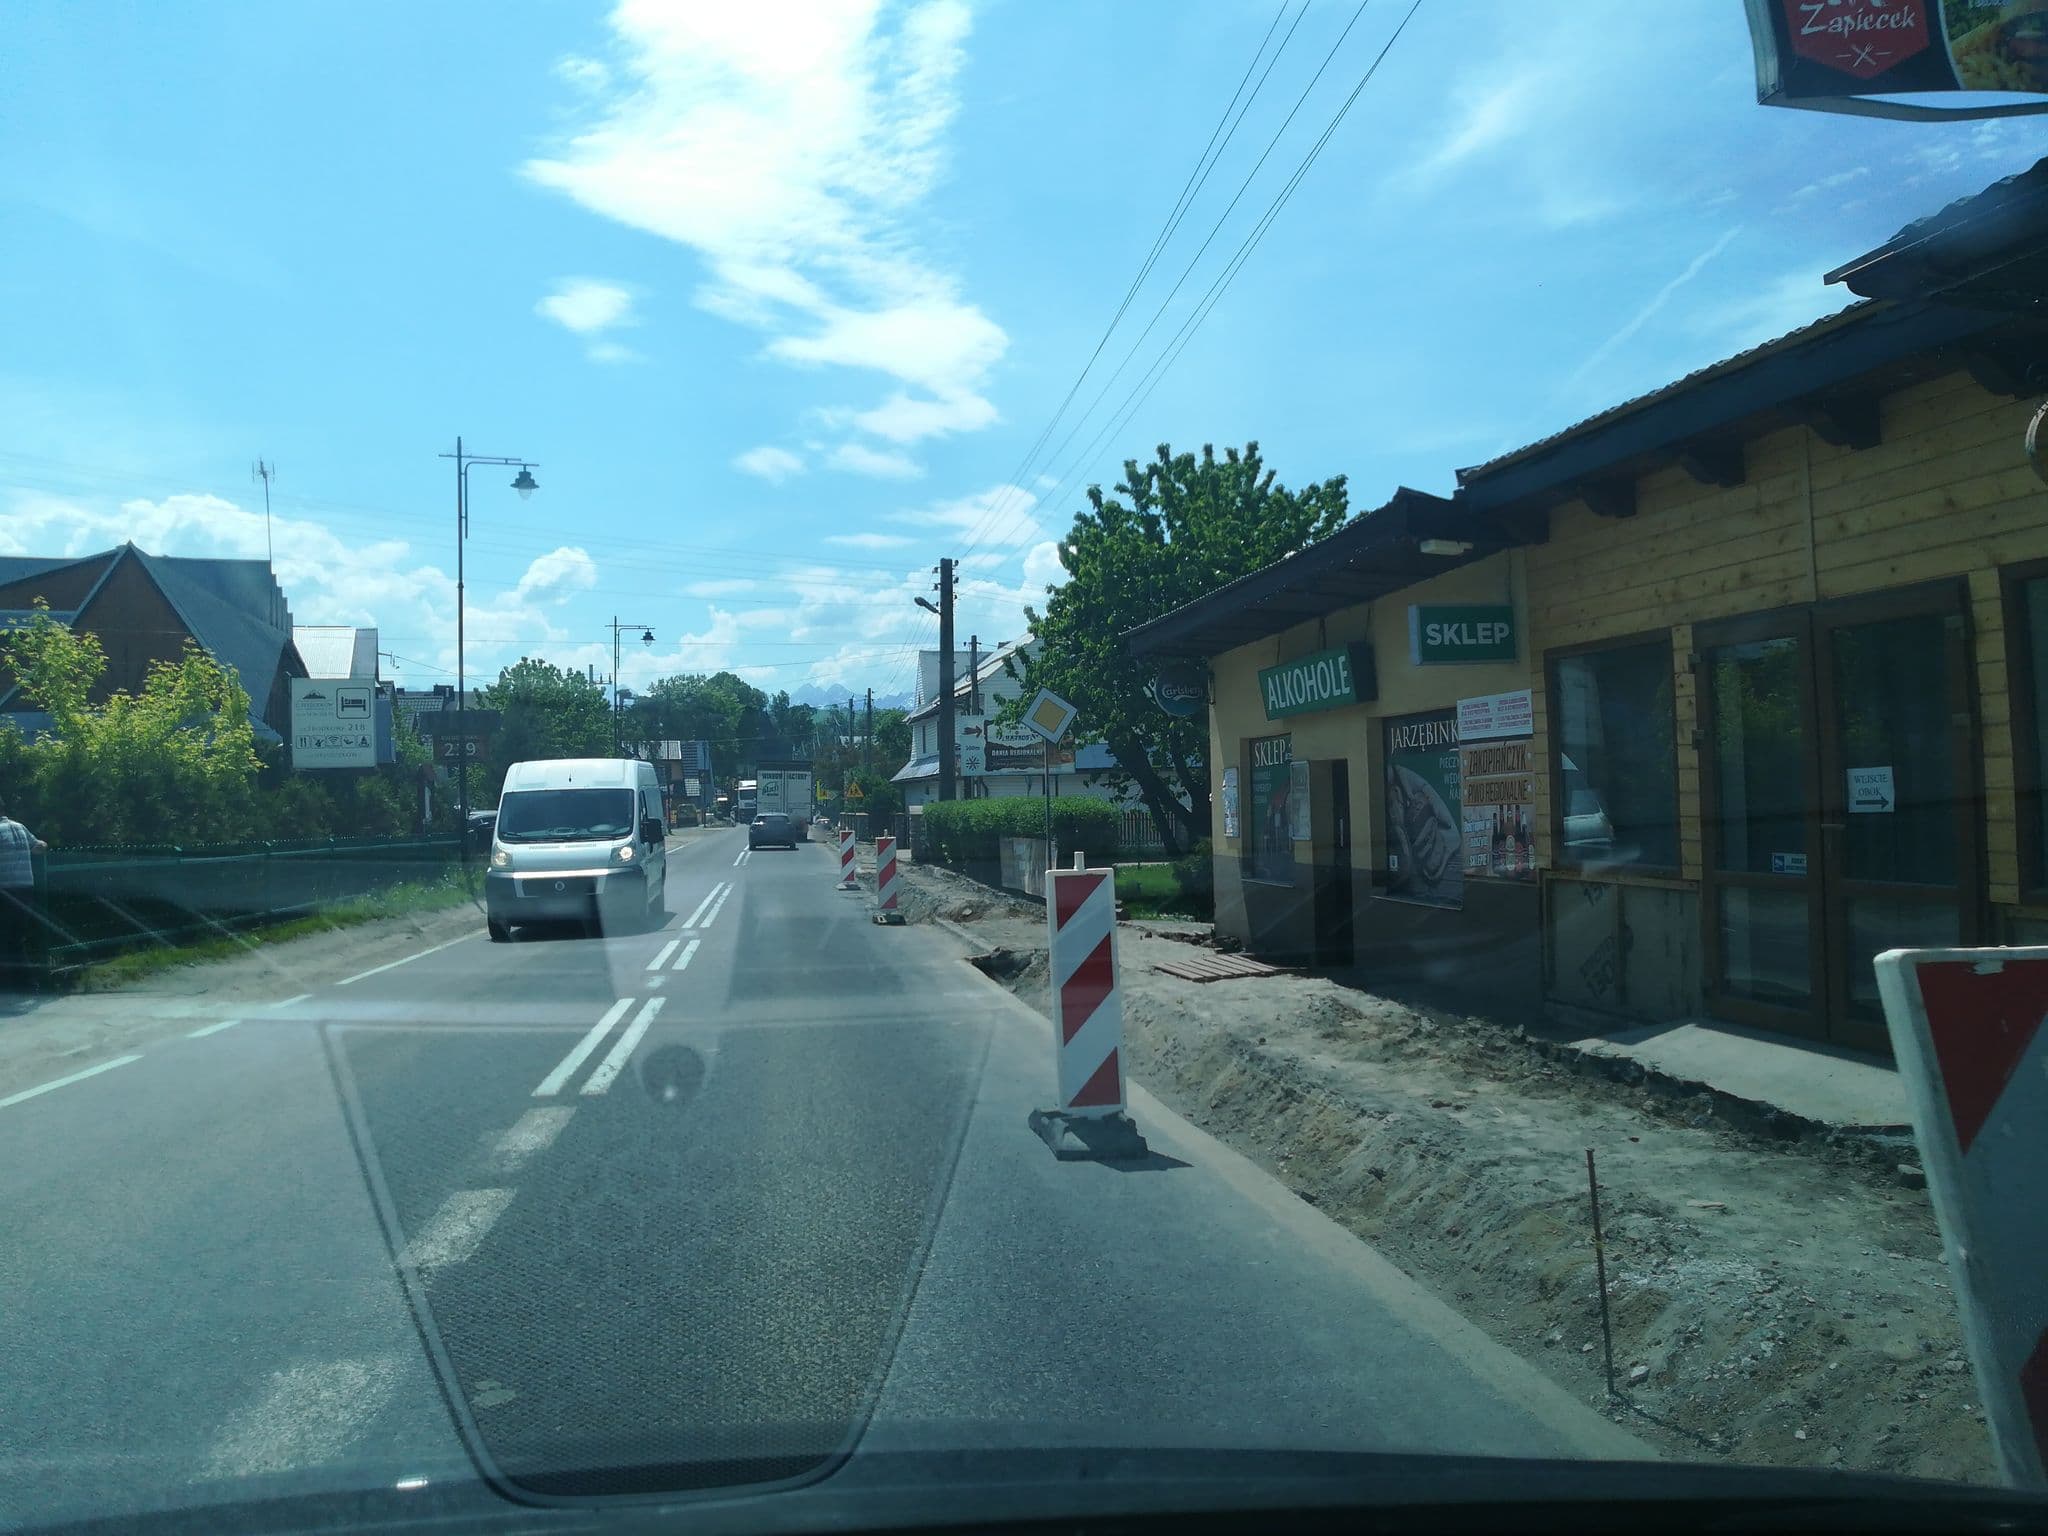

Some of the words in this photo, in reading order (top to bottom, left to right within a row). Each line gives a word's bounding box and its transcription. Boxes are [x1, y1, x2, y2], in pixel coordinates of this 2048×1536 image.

[1799, 5, 1917, 39] Zapiecek
[1426, 622, 1510, 646] SKLEP
[1267, 655, 1351, 711] ALKOHOLE
[443, 741, 476, 757] 29
[1254, 738, 1286, 768] SKLEP
[1390, 719, 1459, 754] JARZĘBINK
[1469, 741, 1527, 775] ZAKOPIAŃCZYK
